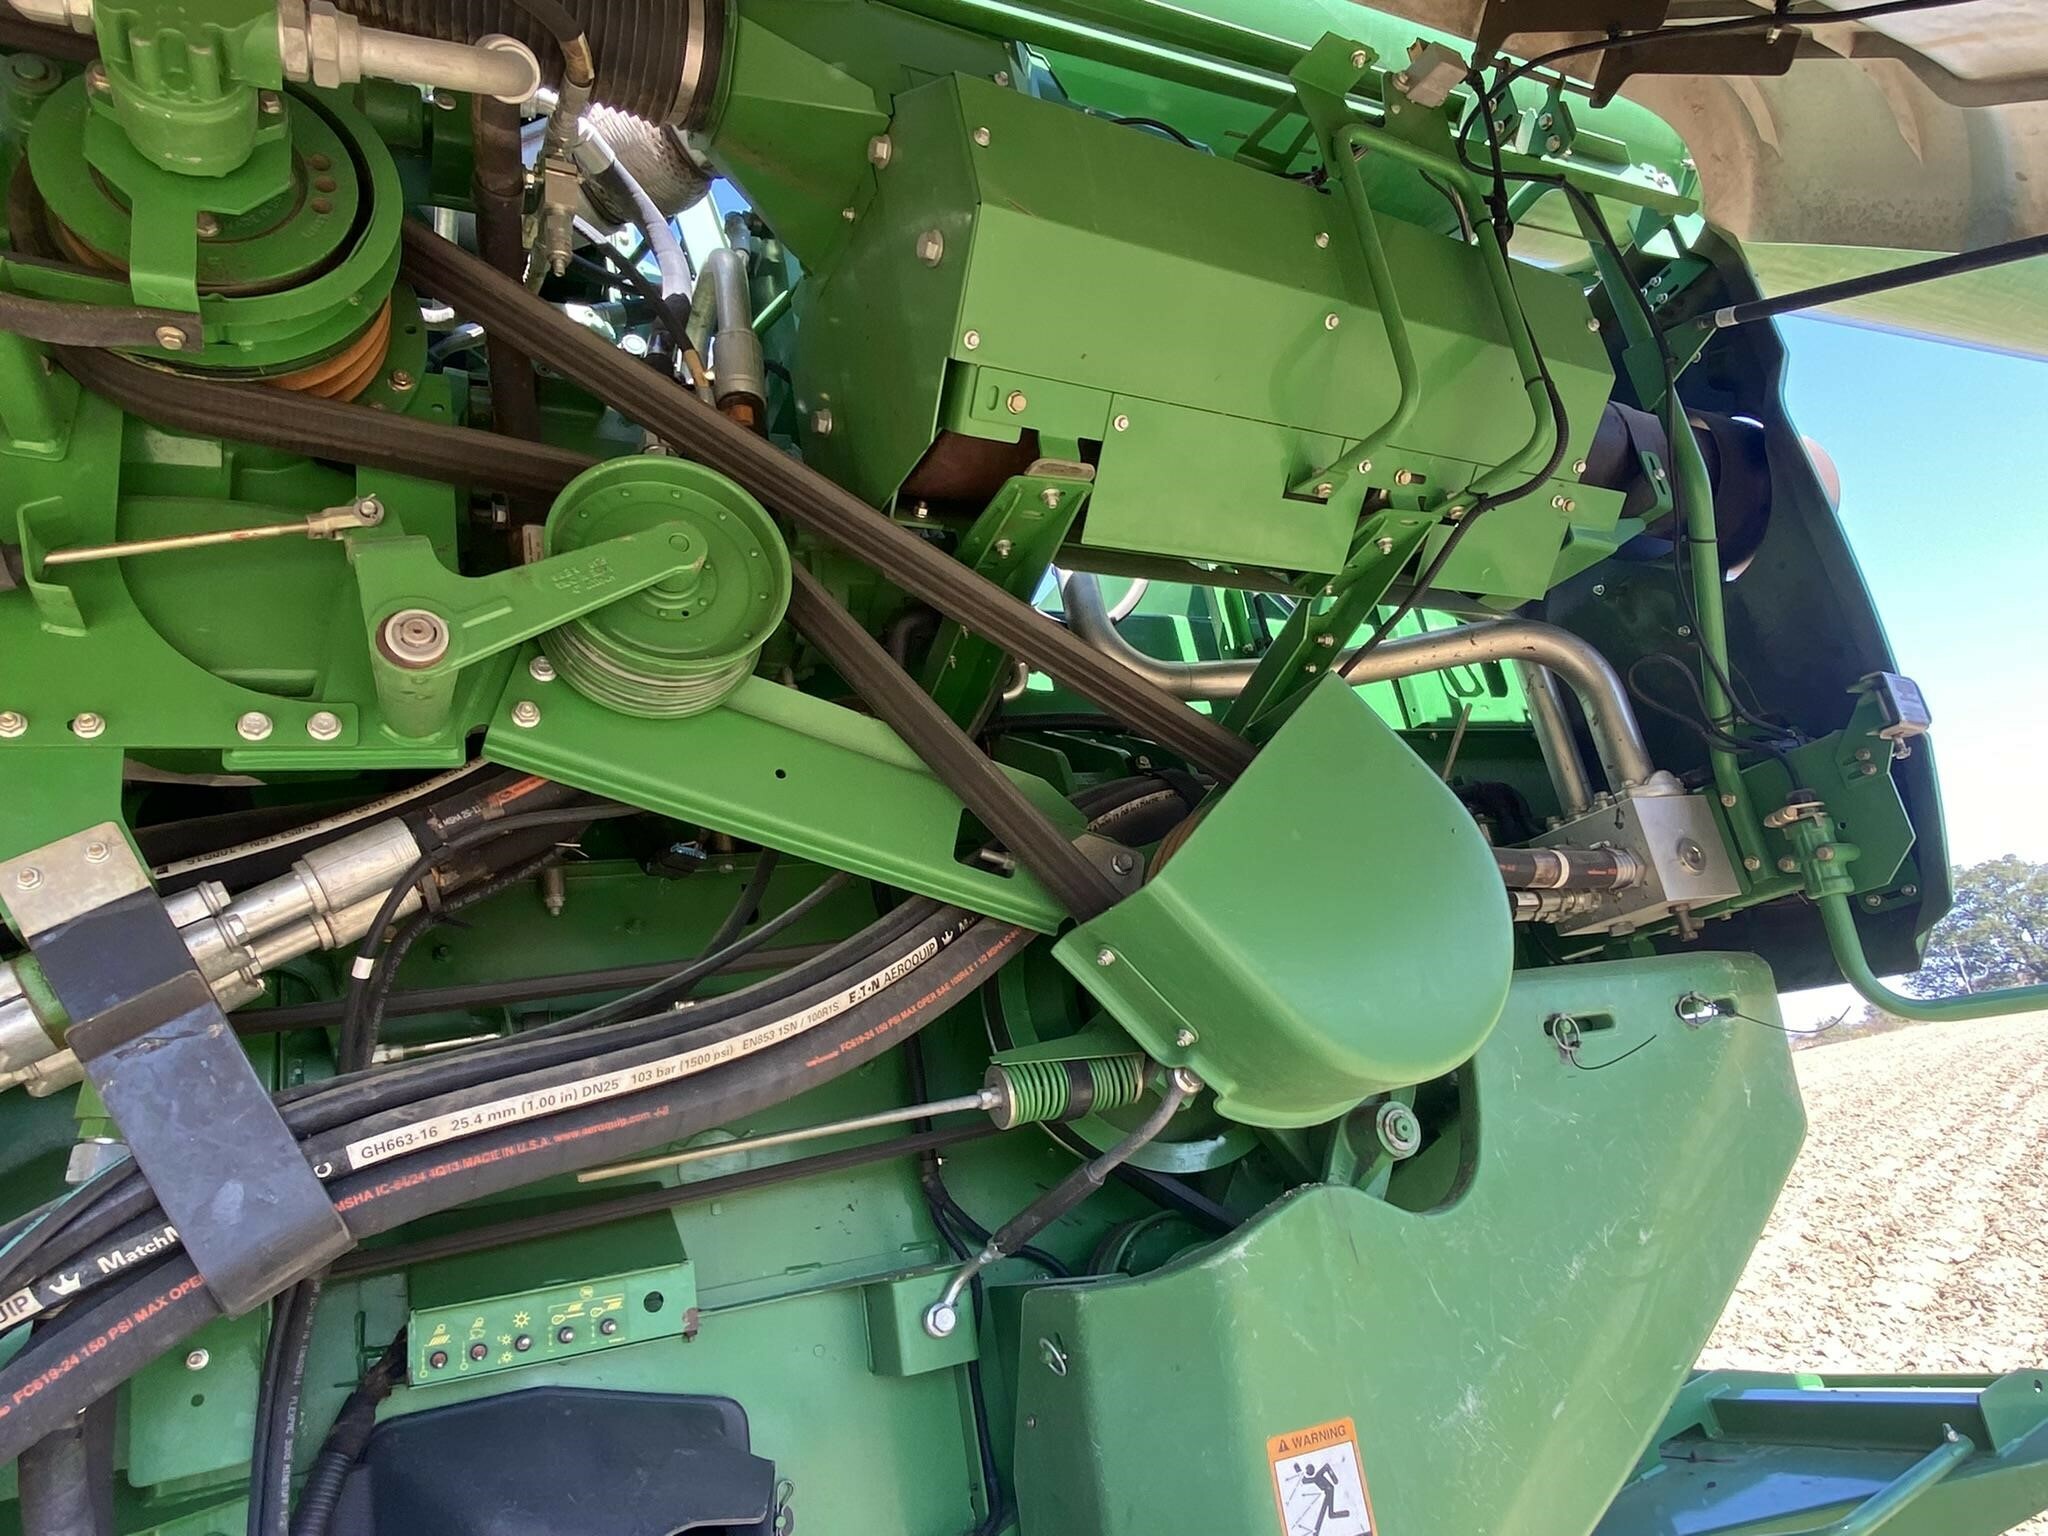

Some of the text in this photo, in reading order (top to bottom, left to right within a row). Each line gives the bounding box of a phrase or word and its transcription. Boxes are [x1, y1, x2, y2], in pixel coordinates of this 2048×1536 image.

[361, 1126, 438, 1159] GH663-16
[451, 1114, 482, 1132] 25.4
[487, 1107, 516, 1122] mm
[521, 1095, 556, 1114] (1.00
[560, 1088, 578, 1104] in)
[582, 1079, 619, 1098] DN25
[630, 1071, 652, 1084] 103
[656, 1065, 676, 1078] bar
[680, 1053, 711, 1072] (1500
[714, 1045, 734, 1062] psi)
[743, 1030, 776, 1050] EN853
[779, 1021, 798, 1036] 1SN
[800, 1015, 805, 1027] /
[807, 1001, 840, 1023] 100R1S
[883, 941, 936, 985] AEROQUIP
[463, 1148, 500, 1168] MADE
[500, 1146, 514, 1159] IN
[97, 1226, 181, 1274] MatchM
[13, 1353, 80, 1404] FC619-24
[80, 1336, 107, 1357] 150
[108, 1317, 134, 1341] PSI
[133, 1296, 169, 1324] MAX
[1291, 1424, 1346, 1449] WARNING
